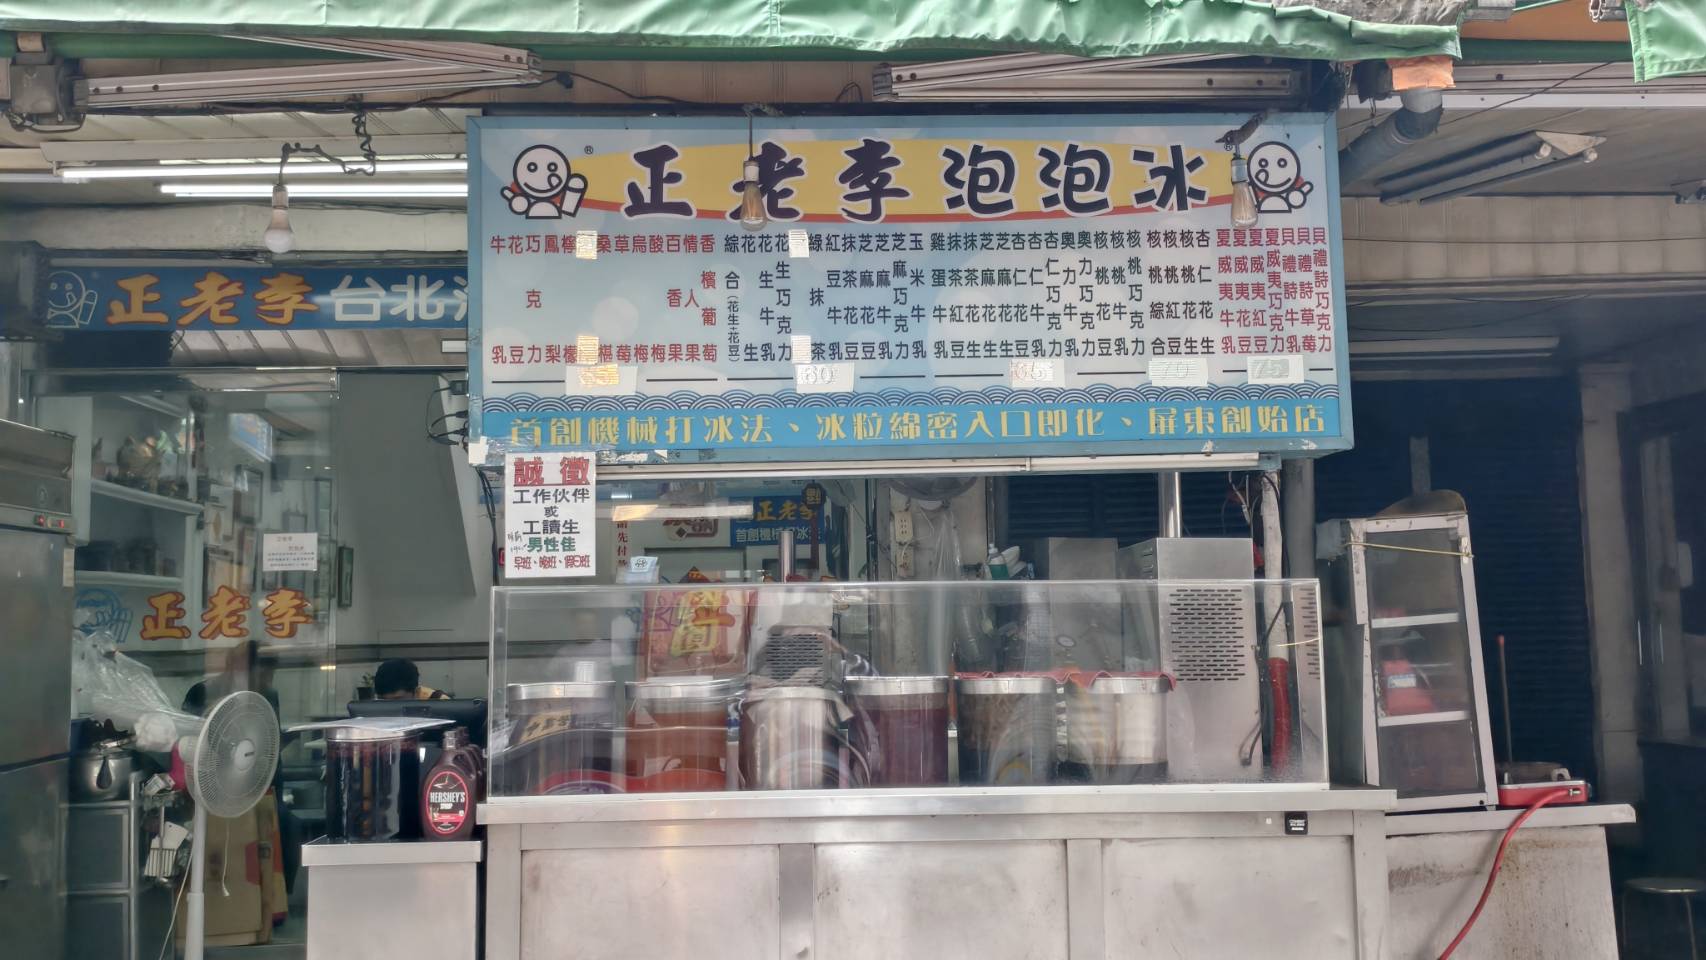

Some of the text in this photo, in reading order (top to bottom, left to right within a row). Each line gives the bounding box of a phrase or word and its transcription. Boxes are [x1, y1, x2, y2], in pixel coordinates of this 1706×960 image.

[623, 138, 1208, 222] 正老李泡泡冰
[490, 235, 507, 364] 牛乳
[508, 235, 525, 364] 花豆
[525, 235, 542, 364] 巧克力
[544, 234, 561, 364] 鳳梨
[614, 234, 631, 363] 草莓
[632, 234, 649, 362] 烏梅
[649, 234, 666, 362] 酸梅
[666, 234, 683, 362] 百香果
[683, 234, 701, 362] 情人果
[700, 234, 717, 362] 香檳葡萄
[741, 234, 758, 362] 花生
[758, 233, 775, 362] 花生牛乳
[774, 233, 791, 362] 花生巧克力
[809, 233, 826, 361] 綠抹茶
[825, 233, 842, 360] 紅豆牛乳
[841, 233, 859, 360] 抹茶花豆
[858, 233, 876, 360] 芝麻花豆
[875, 232, 892, 360] 芝麻牛乳
[891, 232, 909, 360] 芝麻巧克力
[908, 232, 926, 359] 玉米牛乳
[930, 232, 948, 359] 雞蛋牛乳
[947, 232, 964, 359] 抹茶紅豆
[963, 232, 980, 358] 抹茶花生
[979, 232, 998, 358] 芝麻花生
[996, 232, 1014, 358] 芝麻花生
[1011, 231, 1029, 358] 杏仁花豆
[1028, 231, 1045, 357] 杏仁牛乳
[1044, 231, 1062, 357] 杏仁巧克力
[1061, 231, 1079, 357] 奧力牛乳
[1077, 231, 1095, 357] 奧力巧克力
[1094, 231, 1112, 357] 核桃花豆
[1110, 231, 1129, 356] 核桃牛乳
[1127, 231, 1145, 356] 核桃巧克力
[1147, 230, 1166, 355] 核桃綜合
[1163, 230, 1182, 355] 核桃紅豆
[1179, 230, 1199, 355] 核桃花生
[1196, 229, 1215, 355] 杏仁花生
[1216, 228, 1235, 354] 夏威夷牛乳
[1233, 228, 1252, 354] 夏威夷花豆
[1249, 228, 1268, 354] 夏威夷紅豆
[1265, 228, 1284, 353] 夏威夷巧克力
[1282, 228, 1301, 353] 貝禮詩牛乳
[1297, 227, 1317, 353] 貝禮詩草莓
[1313, 227, 1332, 353] 貝禮詩巧克力
[510, 404, 1325, 447] 首創機械打冰法、冰粒綿密入口即化、屏東創始店
[512, 488, 590, 504] 工作伙伴
[523, 519, 580, 534] 工讀生
[527, 536, 576, 553] 男性佳
[544, 506, 559, 518] 或
[141, 585, 313, 640] 正老李
[430, 791, 466, 803] HERSHEY'S
